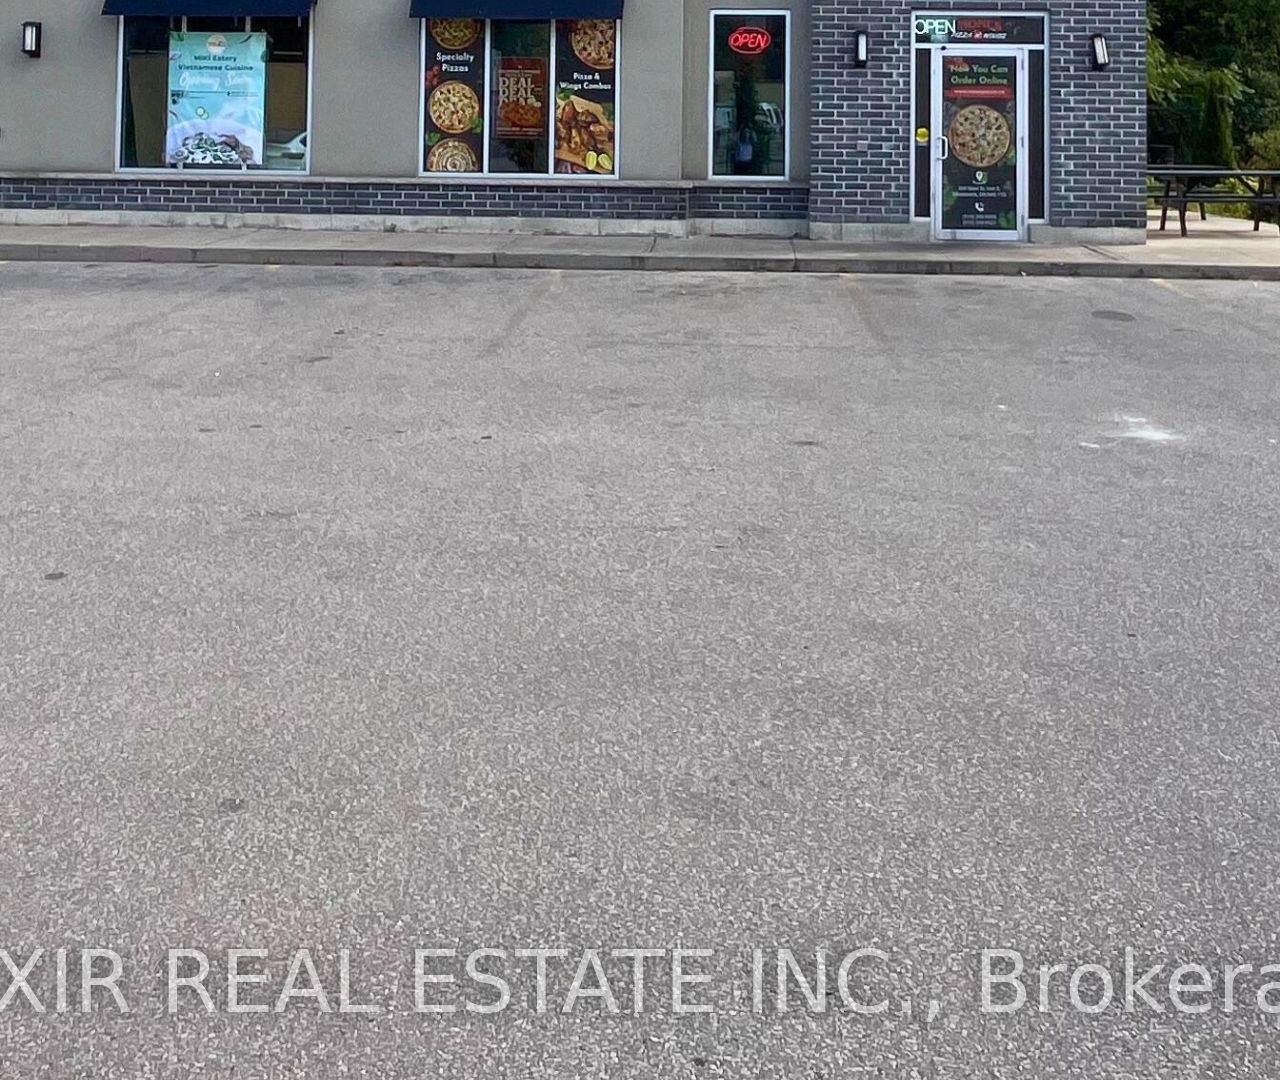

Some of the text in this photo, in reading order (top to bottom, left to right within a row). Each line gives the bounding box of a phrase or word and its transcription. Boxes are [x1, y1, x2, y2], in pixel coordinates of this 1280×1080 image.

[914, 19, 956, 35] OPEN
[730, 32, 768, 48] OPEN
[436, 51, 475, 63] Specialty
[178, 63, 254, 71] Vietnamese Cuisine
[441, 63, 469, 72] Pizzas
[972, 64, 989, 73] You
[990, 64, 1009, 73] Can
[498, 76, 535, 89] DEAL
[950, 76, 1008, 85] Order Online
[583, 81, 612, 90] Combos
